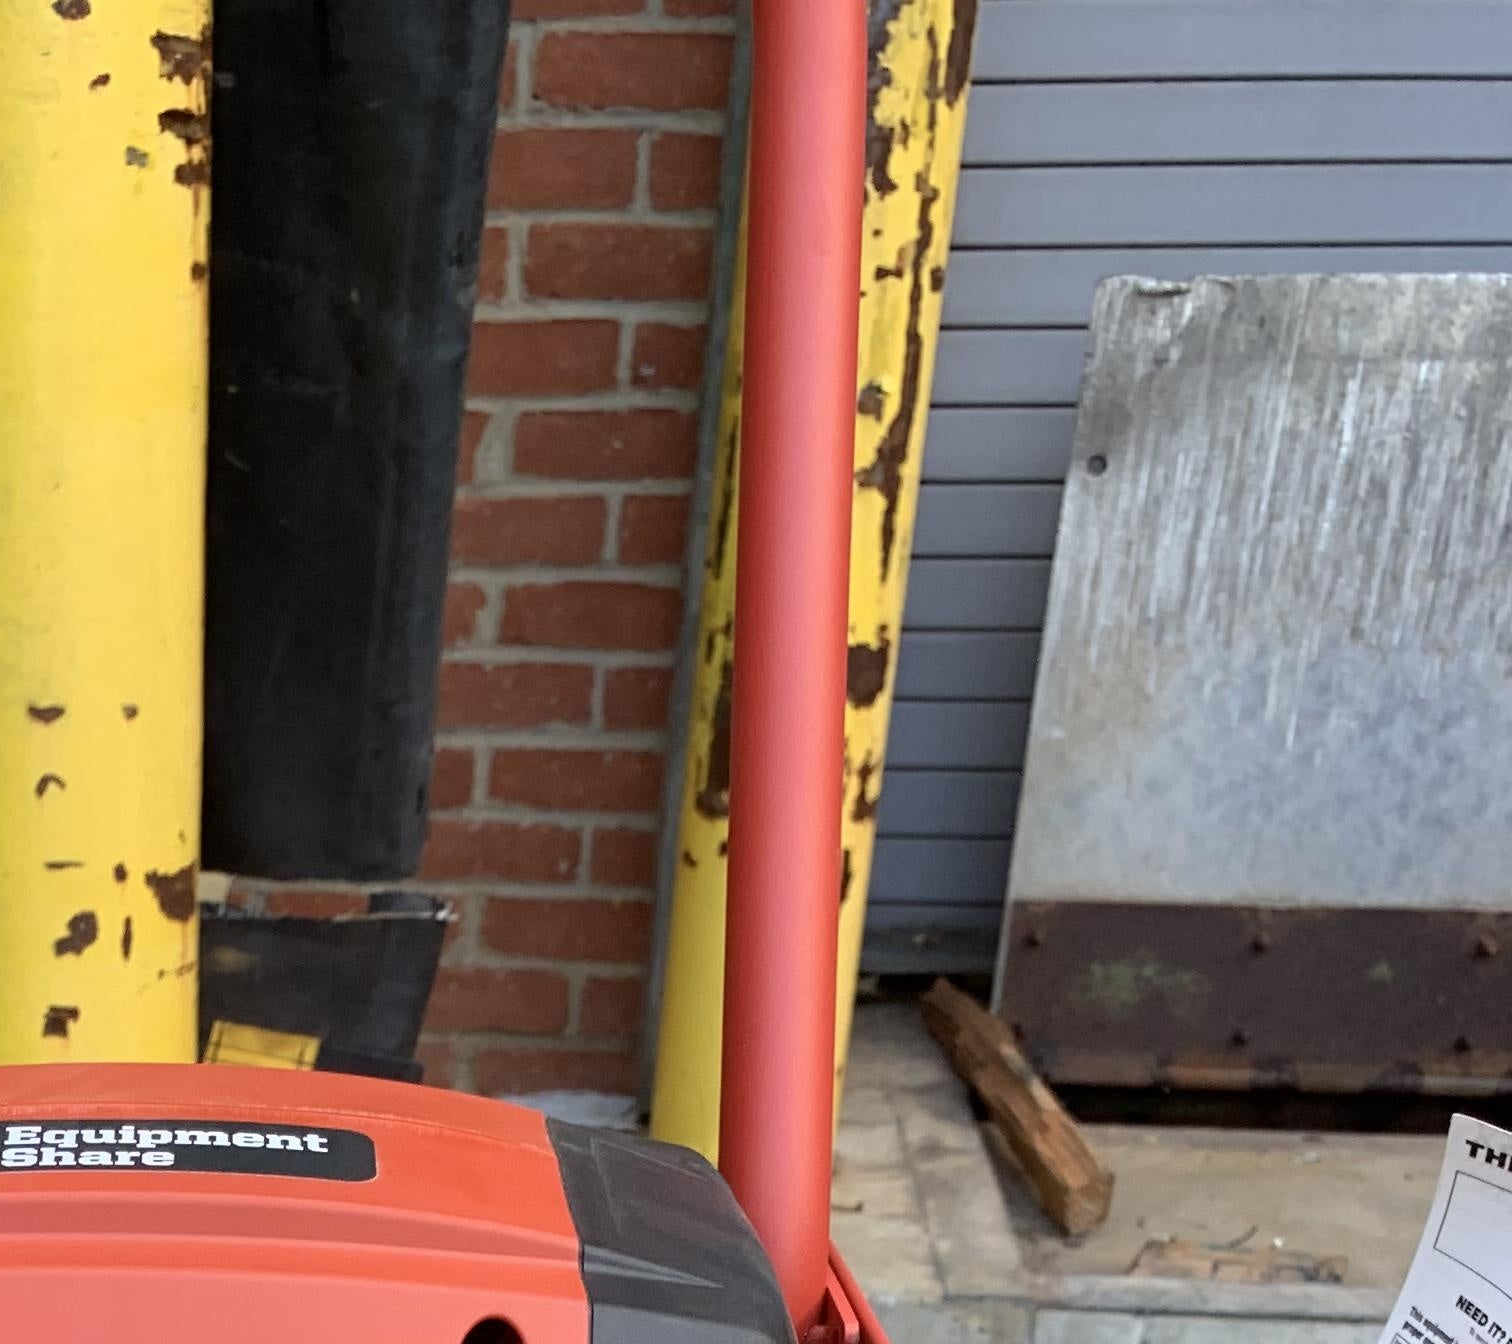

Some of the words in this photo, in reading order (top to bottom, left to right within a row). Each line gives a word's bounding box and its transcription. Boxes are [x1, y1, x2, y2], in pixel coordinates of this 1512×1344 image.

[3, 1125, 329, 1153] Equipment
[0, 1146, 175, 1168] Share
[1455, 1294, 1489, 1326] NEED
[1488, 1322, 1506, 1343] IT?
